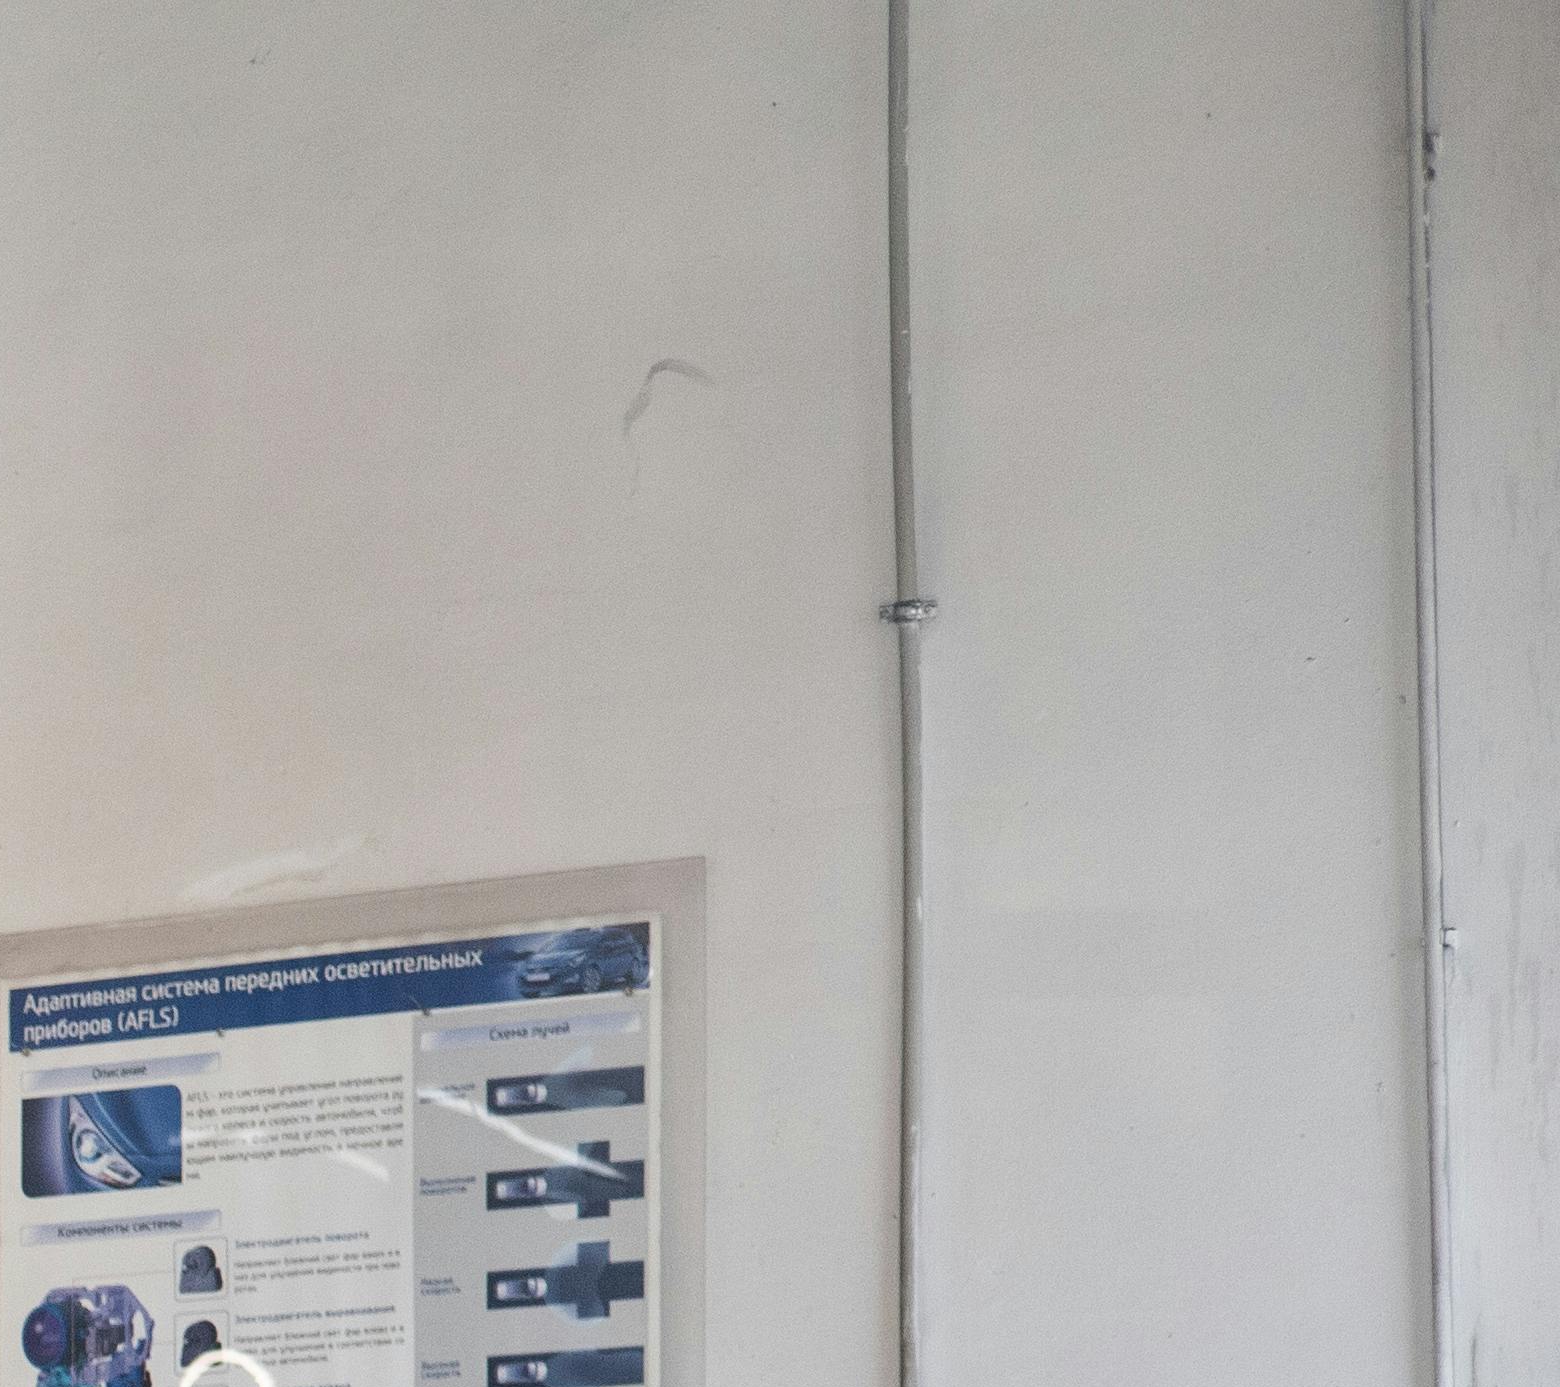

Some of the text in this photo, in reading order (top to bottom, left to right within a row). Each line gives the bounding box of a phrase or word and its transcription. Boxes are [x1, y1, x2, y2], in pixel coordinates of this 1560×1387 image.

[23, 950, 483, 1014] Адаптивная система передних осветительных
[23, 1006, 180, 1045] приборов (AFLS)
